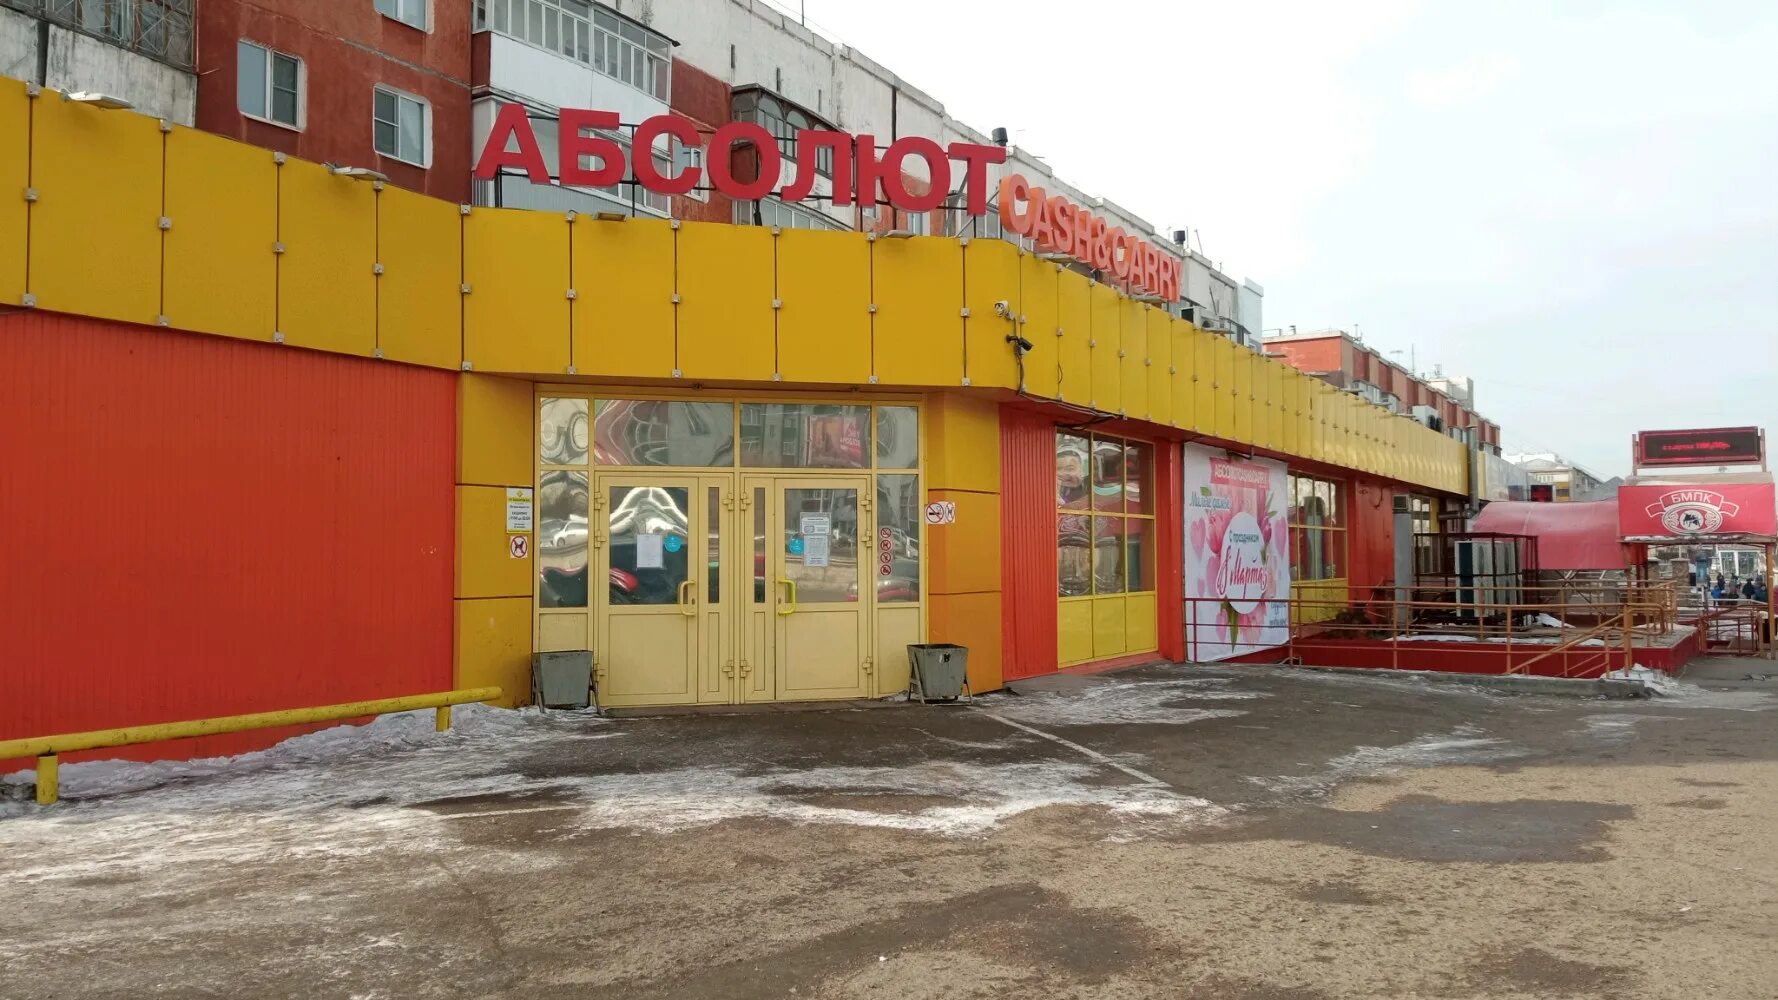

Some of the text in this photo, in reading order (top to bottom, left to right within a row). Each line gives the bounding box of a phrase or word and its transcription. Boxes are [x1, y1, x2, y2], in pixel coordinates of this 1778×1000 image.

[472, 103, 1006, 216] АБСОЛЮТ
[999, 174, 1185, 303] CASH&CARRY
[1671, 492, 1713, 503] БМПК
